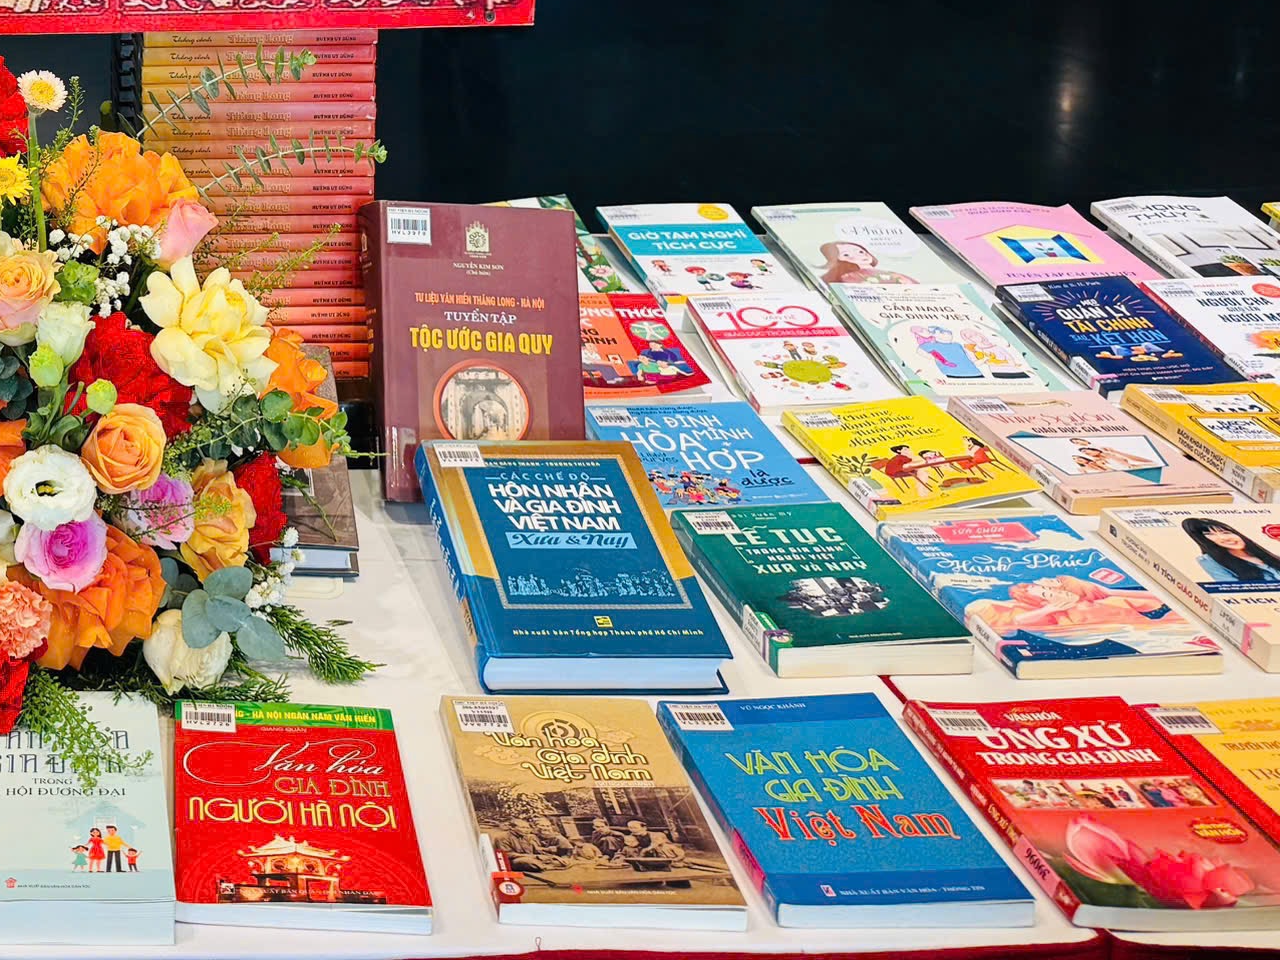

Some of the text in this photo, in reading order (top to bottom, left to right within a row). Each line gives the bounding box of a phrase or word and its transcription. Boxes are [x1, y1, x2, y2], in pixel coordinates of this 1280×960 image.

[652, 240, 694, 250] TÍCH
[425, 293, 438, 305] LIỆU
[439, 293, 454, 303] VĂN
[456, 293, 472, 304] HIẾN
[473, 294, 496, 307] THĂNG
[498, 297, 515, 307] LONG
[521, 297, 530, 307] HÀ
[532, 298, 544, 311] NỘI
[1240, 296, 1271, 307] CHA
[444, 309, 517, 324] TUYỂN TẬP
[1056, 302, 1130, 322] QUẢN LÝ
[1095, 315, 1155, 331] CHÍNH
[410, 325, 552, 354] TỘC ƯỚC GIA QUY
[1088, 329, 1126, 345] KẾT
[1126, 328, 1169, 342] HÔN
[664, 415, 721, 429] ĐÌNH
[620, 432, 708, 454] HÒA
[741, 475, 793, 487] được
[750, 469, 770, 477] là
[488, 483, 612, 498] HÔN NHÂN
[494, 498, 621, 514] VÀ GIA ĐÌNH
[509, 516, 619, 532] VIỆT NAM
[513, 533, 629, 548] Xưa & Nay
[775, 527, 843, 548] TỤC
[827, 561, 866, 571] NAY
[1077, 720, 1131, 749] XỬ
[326, 738, 384, 775] hóa
[536, 749, 585, 765] Gia
[725, 747, 900, 775] VĂN HÓA
[976, 748, 1161, 767] TRONG GIA ĐÌNH
[522, 762, 652, 783] Việt Nam
[7, 786, 32, 796] HỘI
[38, 787, 94, 796] ĐƯƠNG
[99, 787, 125, 796] ĐẠI
[274, 777, 390, 797] GIA ĐÌNH
[765, 774, 904, 802] GIA ĐÌNH
[189, 796, 397, 831] NGƯỜI HÀ NỘI
[753, 805, 961, 846] Việt Nam
